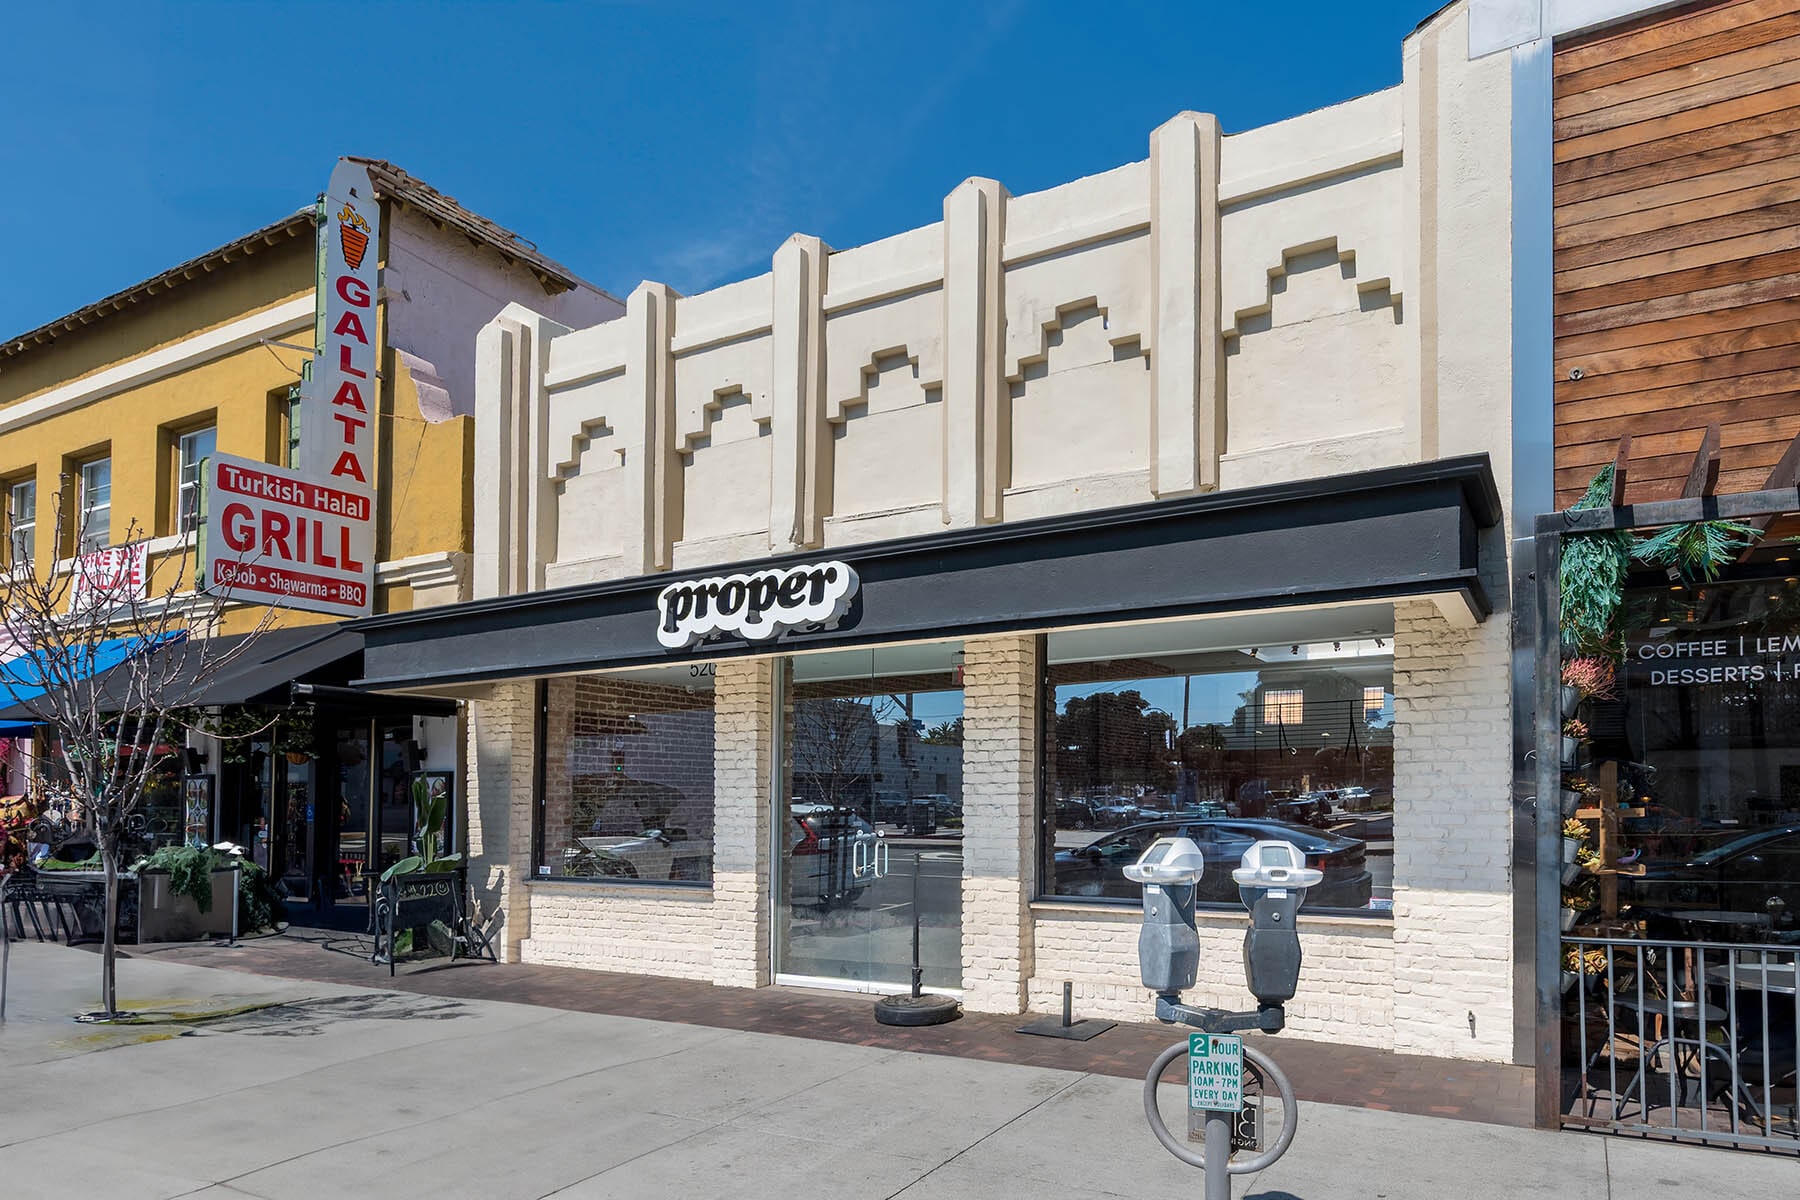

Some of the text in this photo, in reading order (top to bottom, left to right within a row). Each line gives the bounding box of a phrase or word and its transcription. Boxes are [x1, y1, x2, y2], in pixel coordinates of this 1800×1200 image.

[331, 275, 371, 484] GALATA
[226, 467, 363, 518] Turkish Halal
[221, 502, 364, 574] GRILL
[269, 572, 328, 597] Shawarma
[339, 584, 363, 604] BBQ
[663, 566, 838, 634] proper
[1639, 640, 1727, 660] COFFEE
[1651, 664, 1765, 686] DESSERTS
[1193, 1037, 1205, 1054] 2
[1192, 1060, 1239, 1077] PARKING
[1193, 1076, 1214, 1087] 10AM
[1222, 1078, 1238, 1088] 7PM
[1194, 1088, 1238, 1102] EVERY DAY
